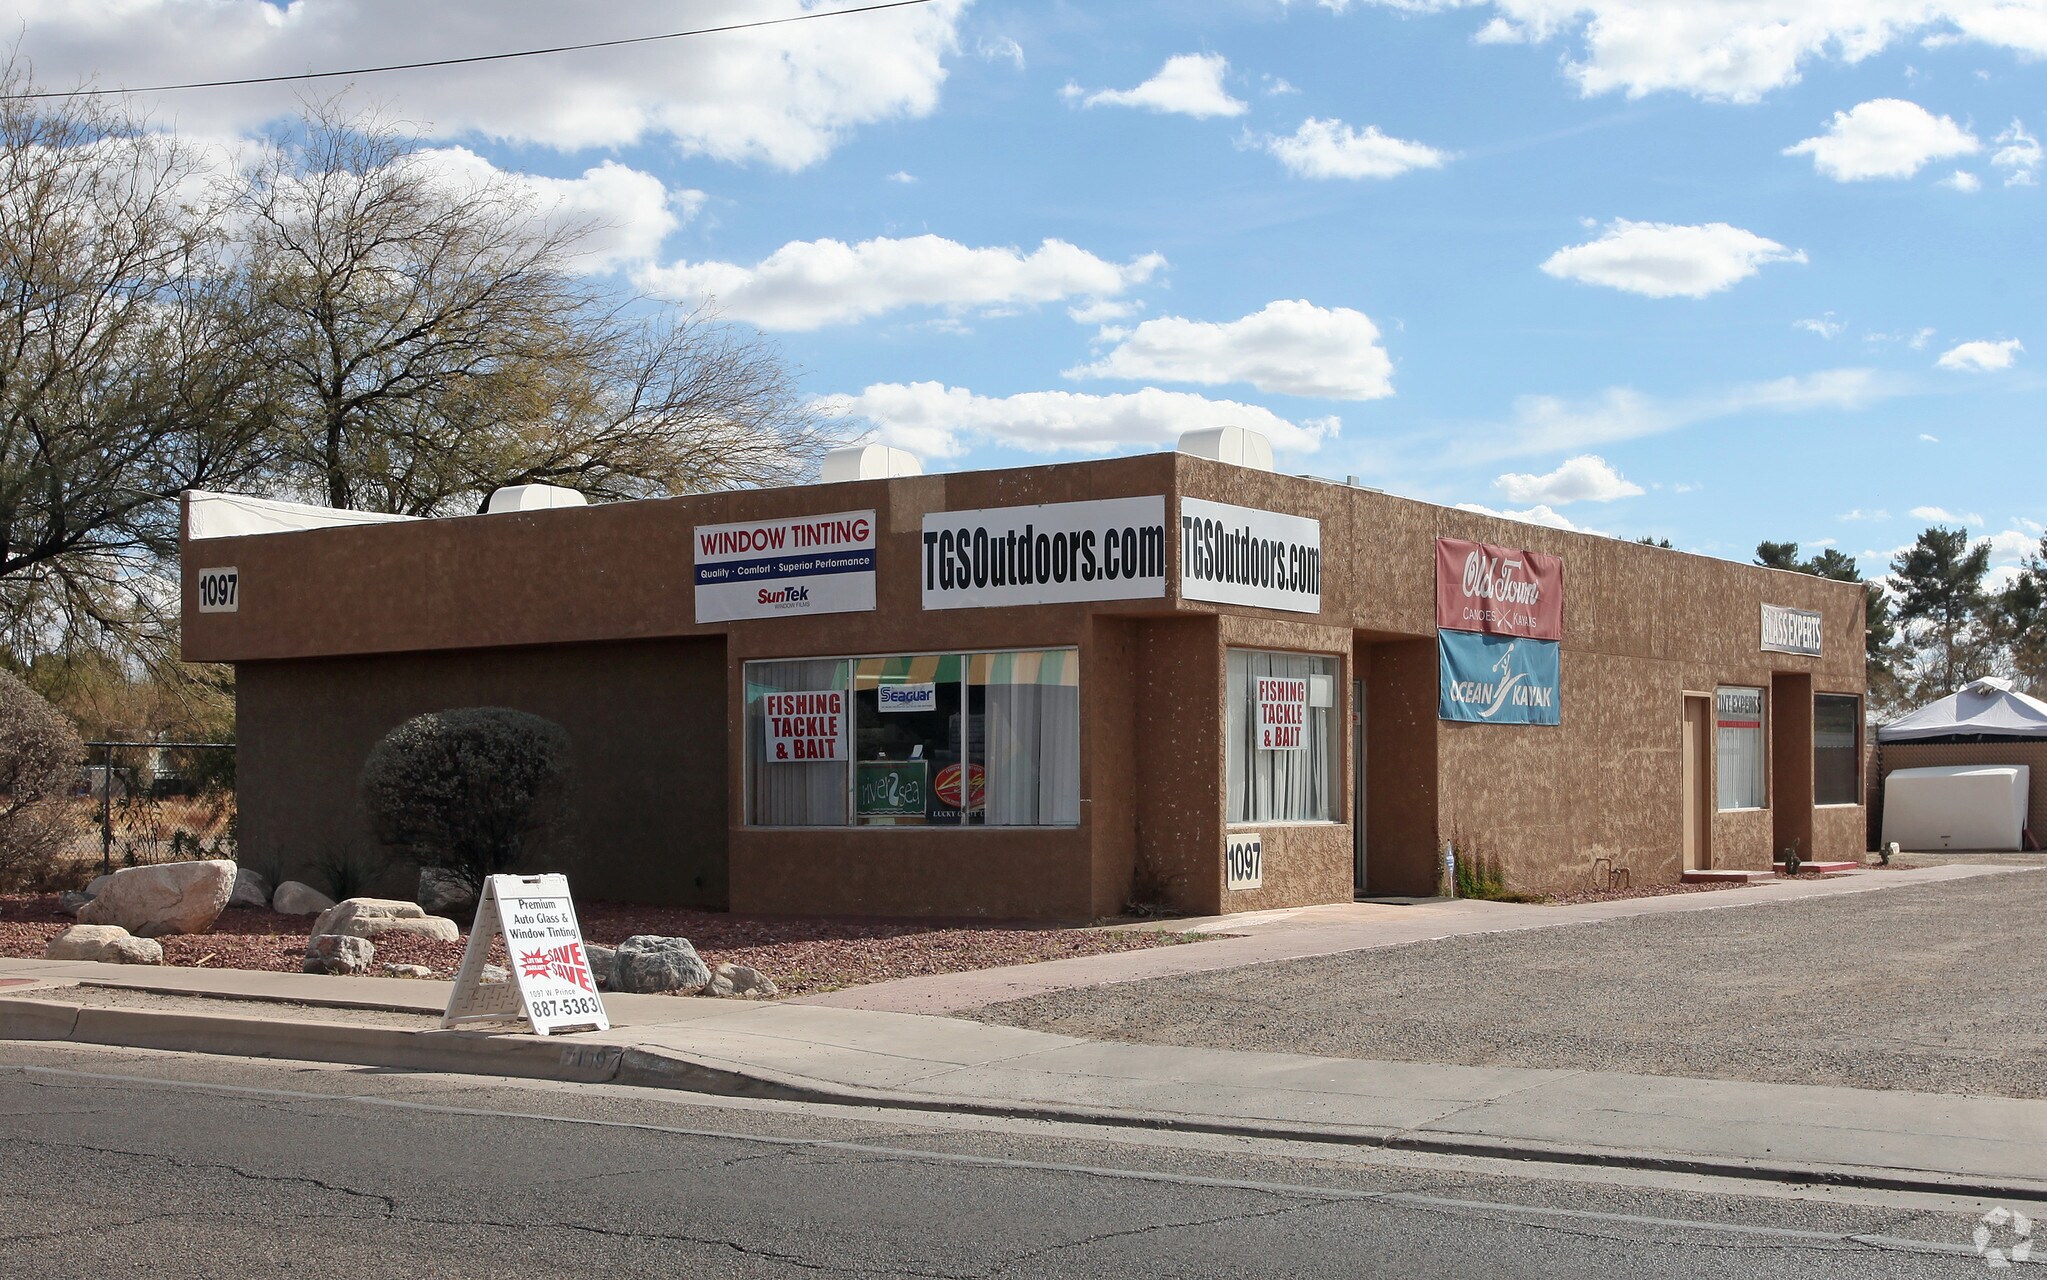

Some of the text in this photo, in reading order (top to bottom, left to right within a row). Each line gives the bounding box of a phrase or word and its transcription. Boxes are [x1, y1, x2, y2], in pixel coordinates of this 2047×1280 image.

[700, 518, 870, 556] WINDOW TINTING
[923, 524, 1164, 591] TGSOutdoors.com
[1182, 515, 1320, 596] TGSOutdoors.com
[701, 556, 870, 579] Quality Comfort Superior Performance
[1462, 549, 1539, 606] Old Town
[200, 574, 238, 606] 1097
[757, 585, 810, 605] SunTek
[775, 601, 811, 610] WINDOW FILMS
[1463, 607, 1497, 622] CANOES
[1789, 613, 1821, 650] EXPERTS
[881, 686, 933, 703] Seaguar
[1259, 680, 1305, 702] FISHING
[1450, 680, 1552, 707] OCEAN KAYAK
[767, 693, 841, 716] FISHING
[1262, 703, 1303, 725] TACKLE
[1732, 695, 1761, 714] EXPERTS
[771, 716, 838, 738] TACKLE
[1264, 727, 1301, 747] & BAIT
[776, 738, 836, 759] & BAIT
[862, 772, 920, 807] river2sea
[933, 810, 956, 818] LUCKY
[1228, 842, 1261, 882] 1097
[518, 899, 556, 910] Premium
[514, 912, 569, 925] Auto Glass &
[509, 927, 577, 940] Window Tinting
[547, 942, 585, 966] SAVE
[551, 963, 593, 993] SAVE
[529, 989, 544, 998] 1097
[555, 988, 576, 996] Prince
[532, 996, 598, 1018] 887-5383
